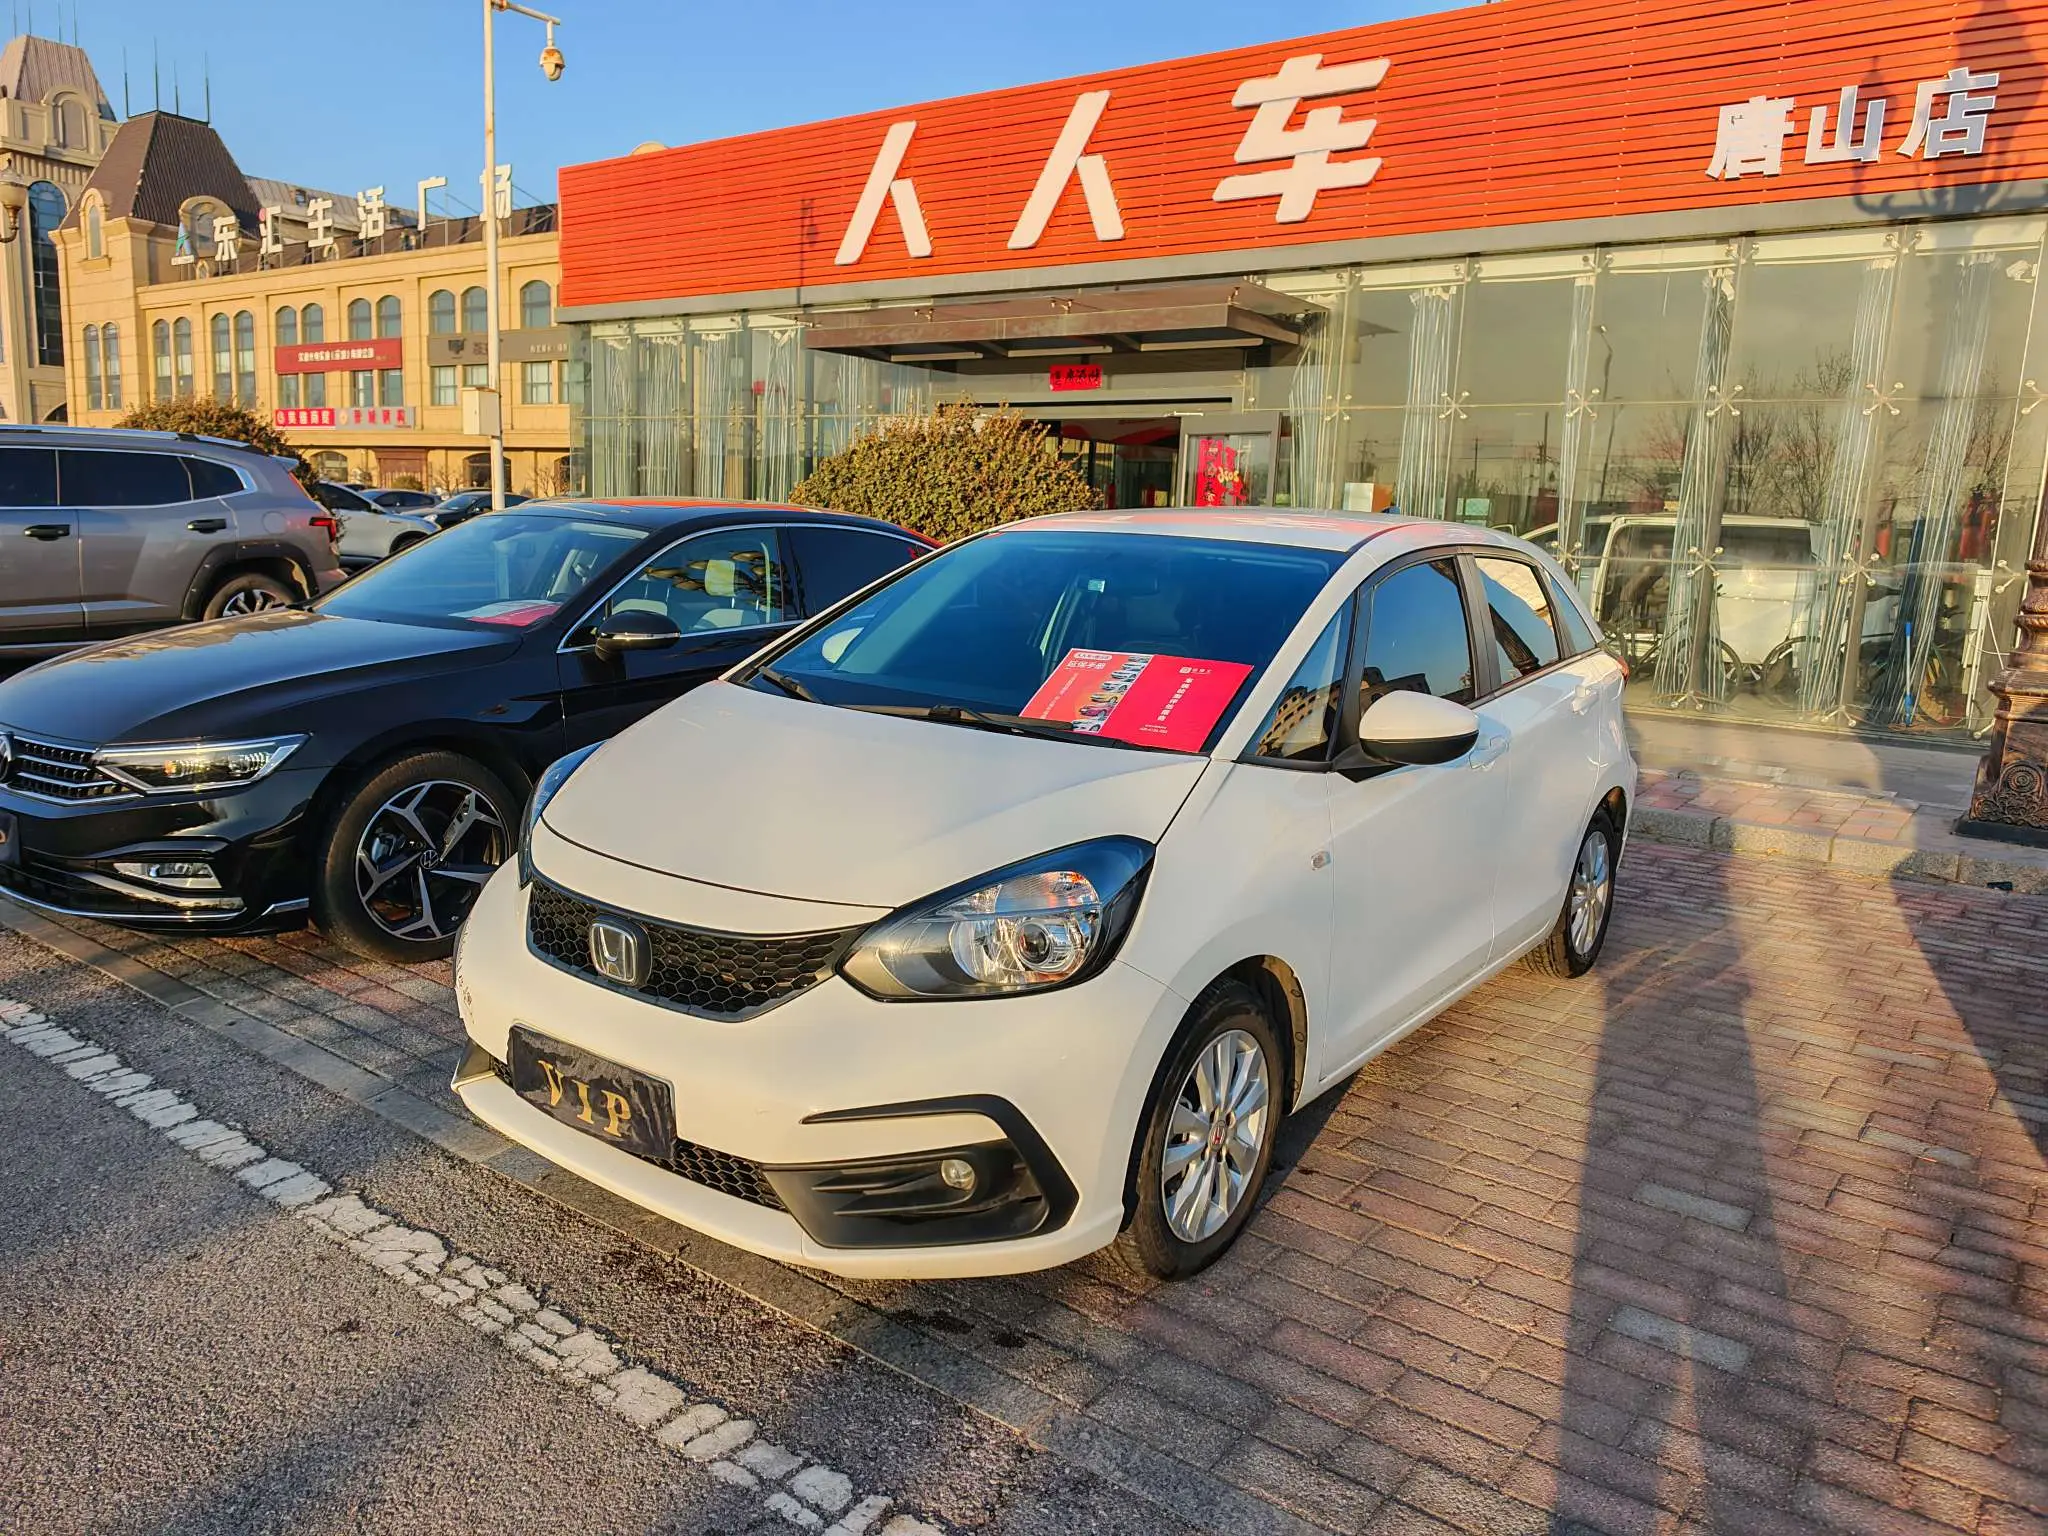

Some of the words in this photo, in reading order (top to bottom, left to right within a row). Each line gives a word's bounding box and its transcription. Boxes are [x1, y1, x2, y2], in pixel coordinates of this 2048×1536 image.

[834, 53, 1391, 266] 人人车
[1706, 67, 2000, 180] 唐山店
[213, 163, 513, 261] 东汇生活广场
[537, 1060, 632, 1137] VIP
